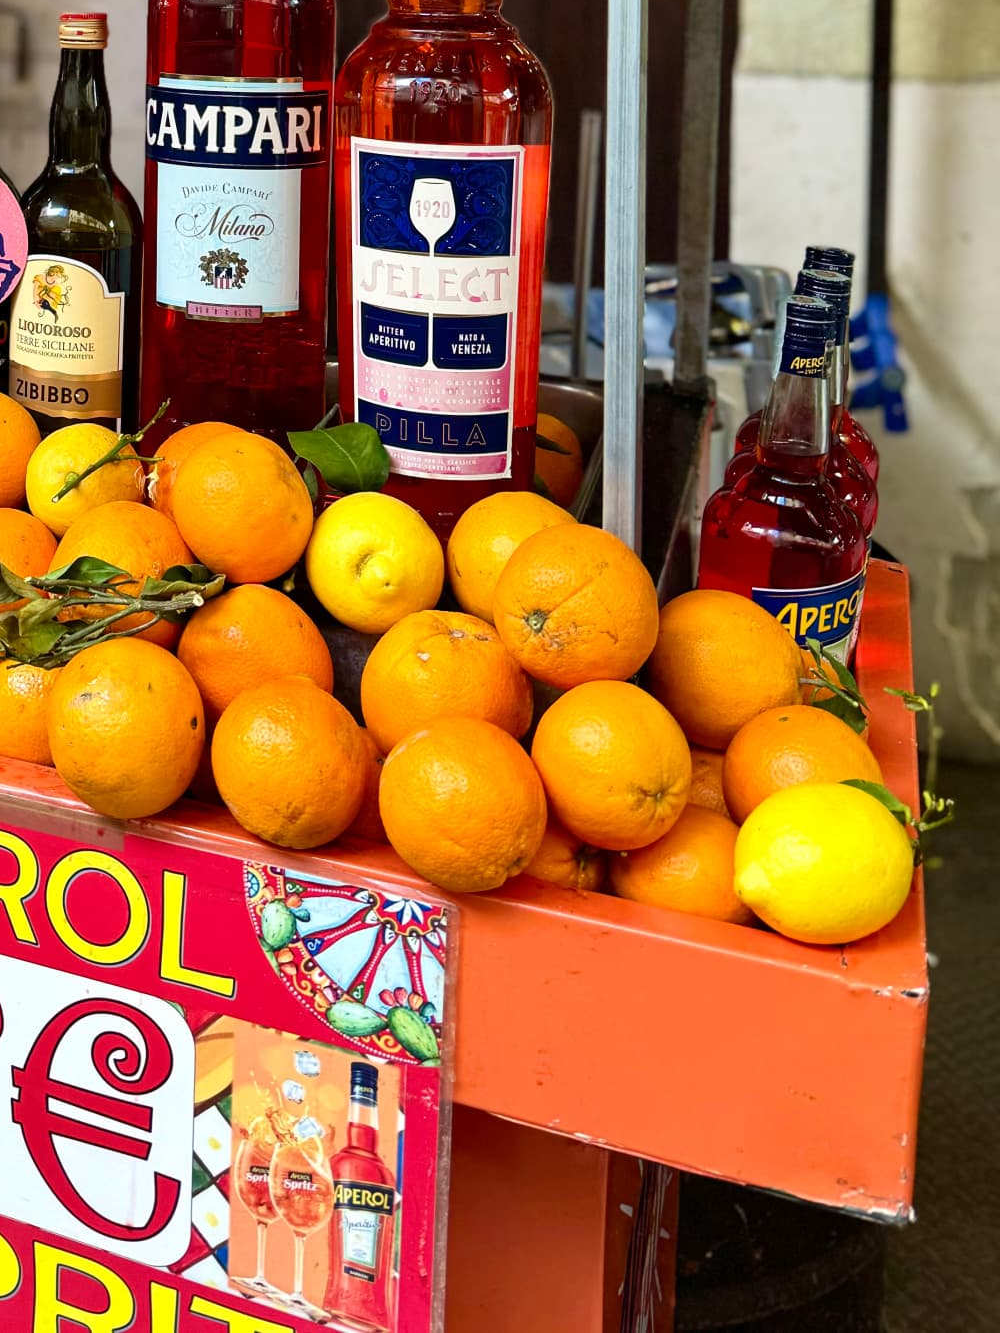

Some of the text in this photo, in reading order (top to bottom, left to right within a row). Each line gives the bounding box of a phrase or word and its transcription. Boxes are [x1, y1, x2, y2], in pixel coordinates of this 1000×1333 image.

[146, 97, 322, 155] CAMPARI
[181, 182, 272, 201] DAVIDE CAMPARI
[414, 200, 450, 219] 1920
[182, 204, 274, 243] Milano
[359, 258, 509, 303] SELECT
[18, 318, 92, 338] LIQUOROSO
[378, 324, 404, 337] BITTER
[458, 333, 485, 342] NATO A
[16, 333, 95, 352] TERRE SICILIANE
[368, 333, 415, 352] APERITIVO
[451, 343, 492, 355] VENEZIA
[16, 378, 89, 405] ZIBIBBO
[375, 413, 487, 446] PILLA
[283, 1179, 318, 1192] Spritz
[334, 1184, 390, 1210] APEROL
